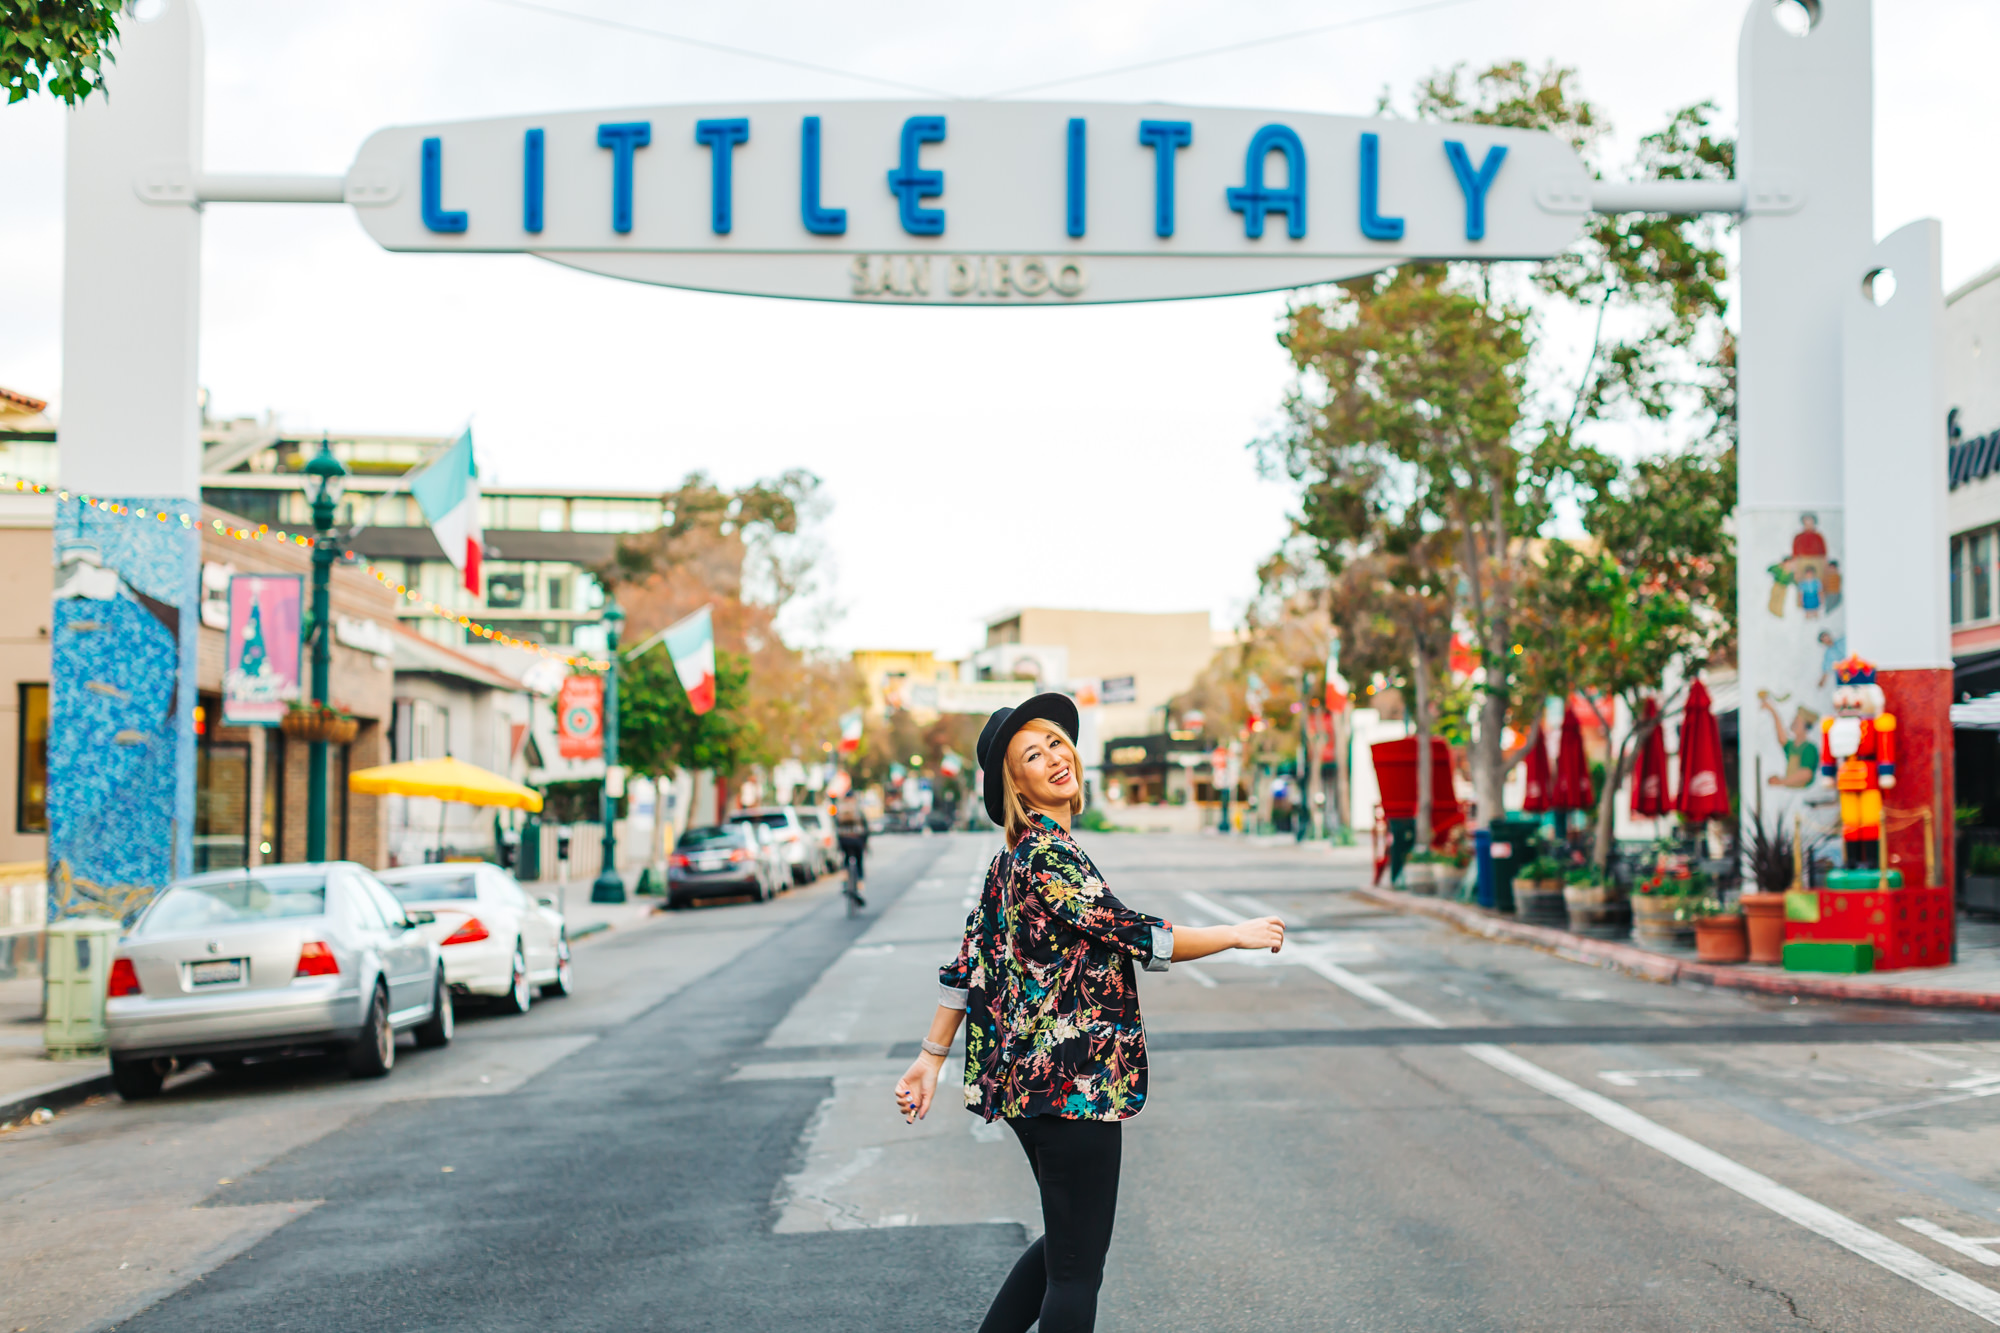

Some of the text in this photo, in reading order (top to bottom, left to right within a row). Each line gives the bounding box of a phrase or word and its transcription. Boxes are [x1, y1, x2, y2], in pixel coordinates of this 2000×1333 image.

[421, 115, 1509, 240] LITTLE ITALY
[851, 255, 1086, 297] SAN DIEGO
